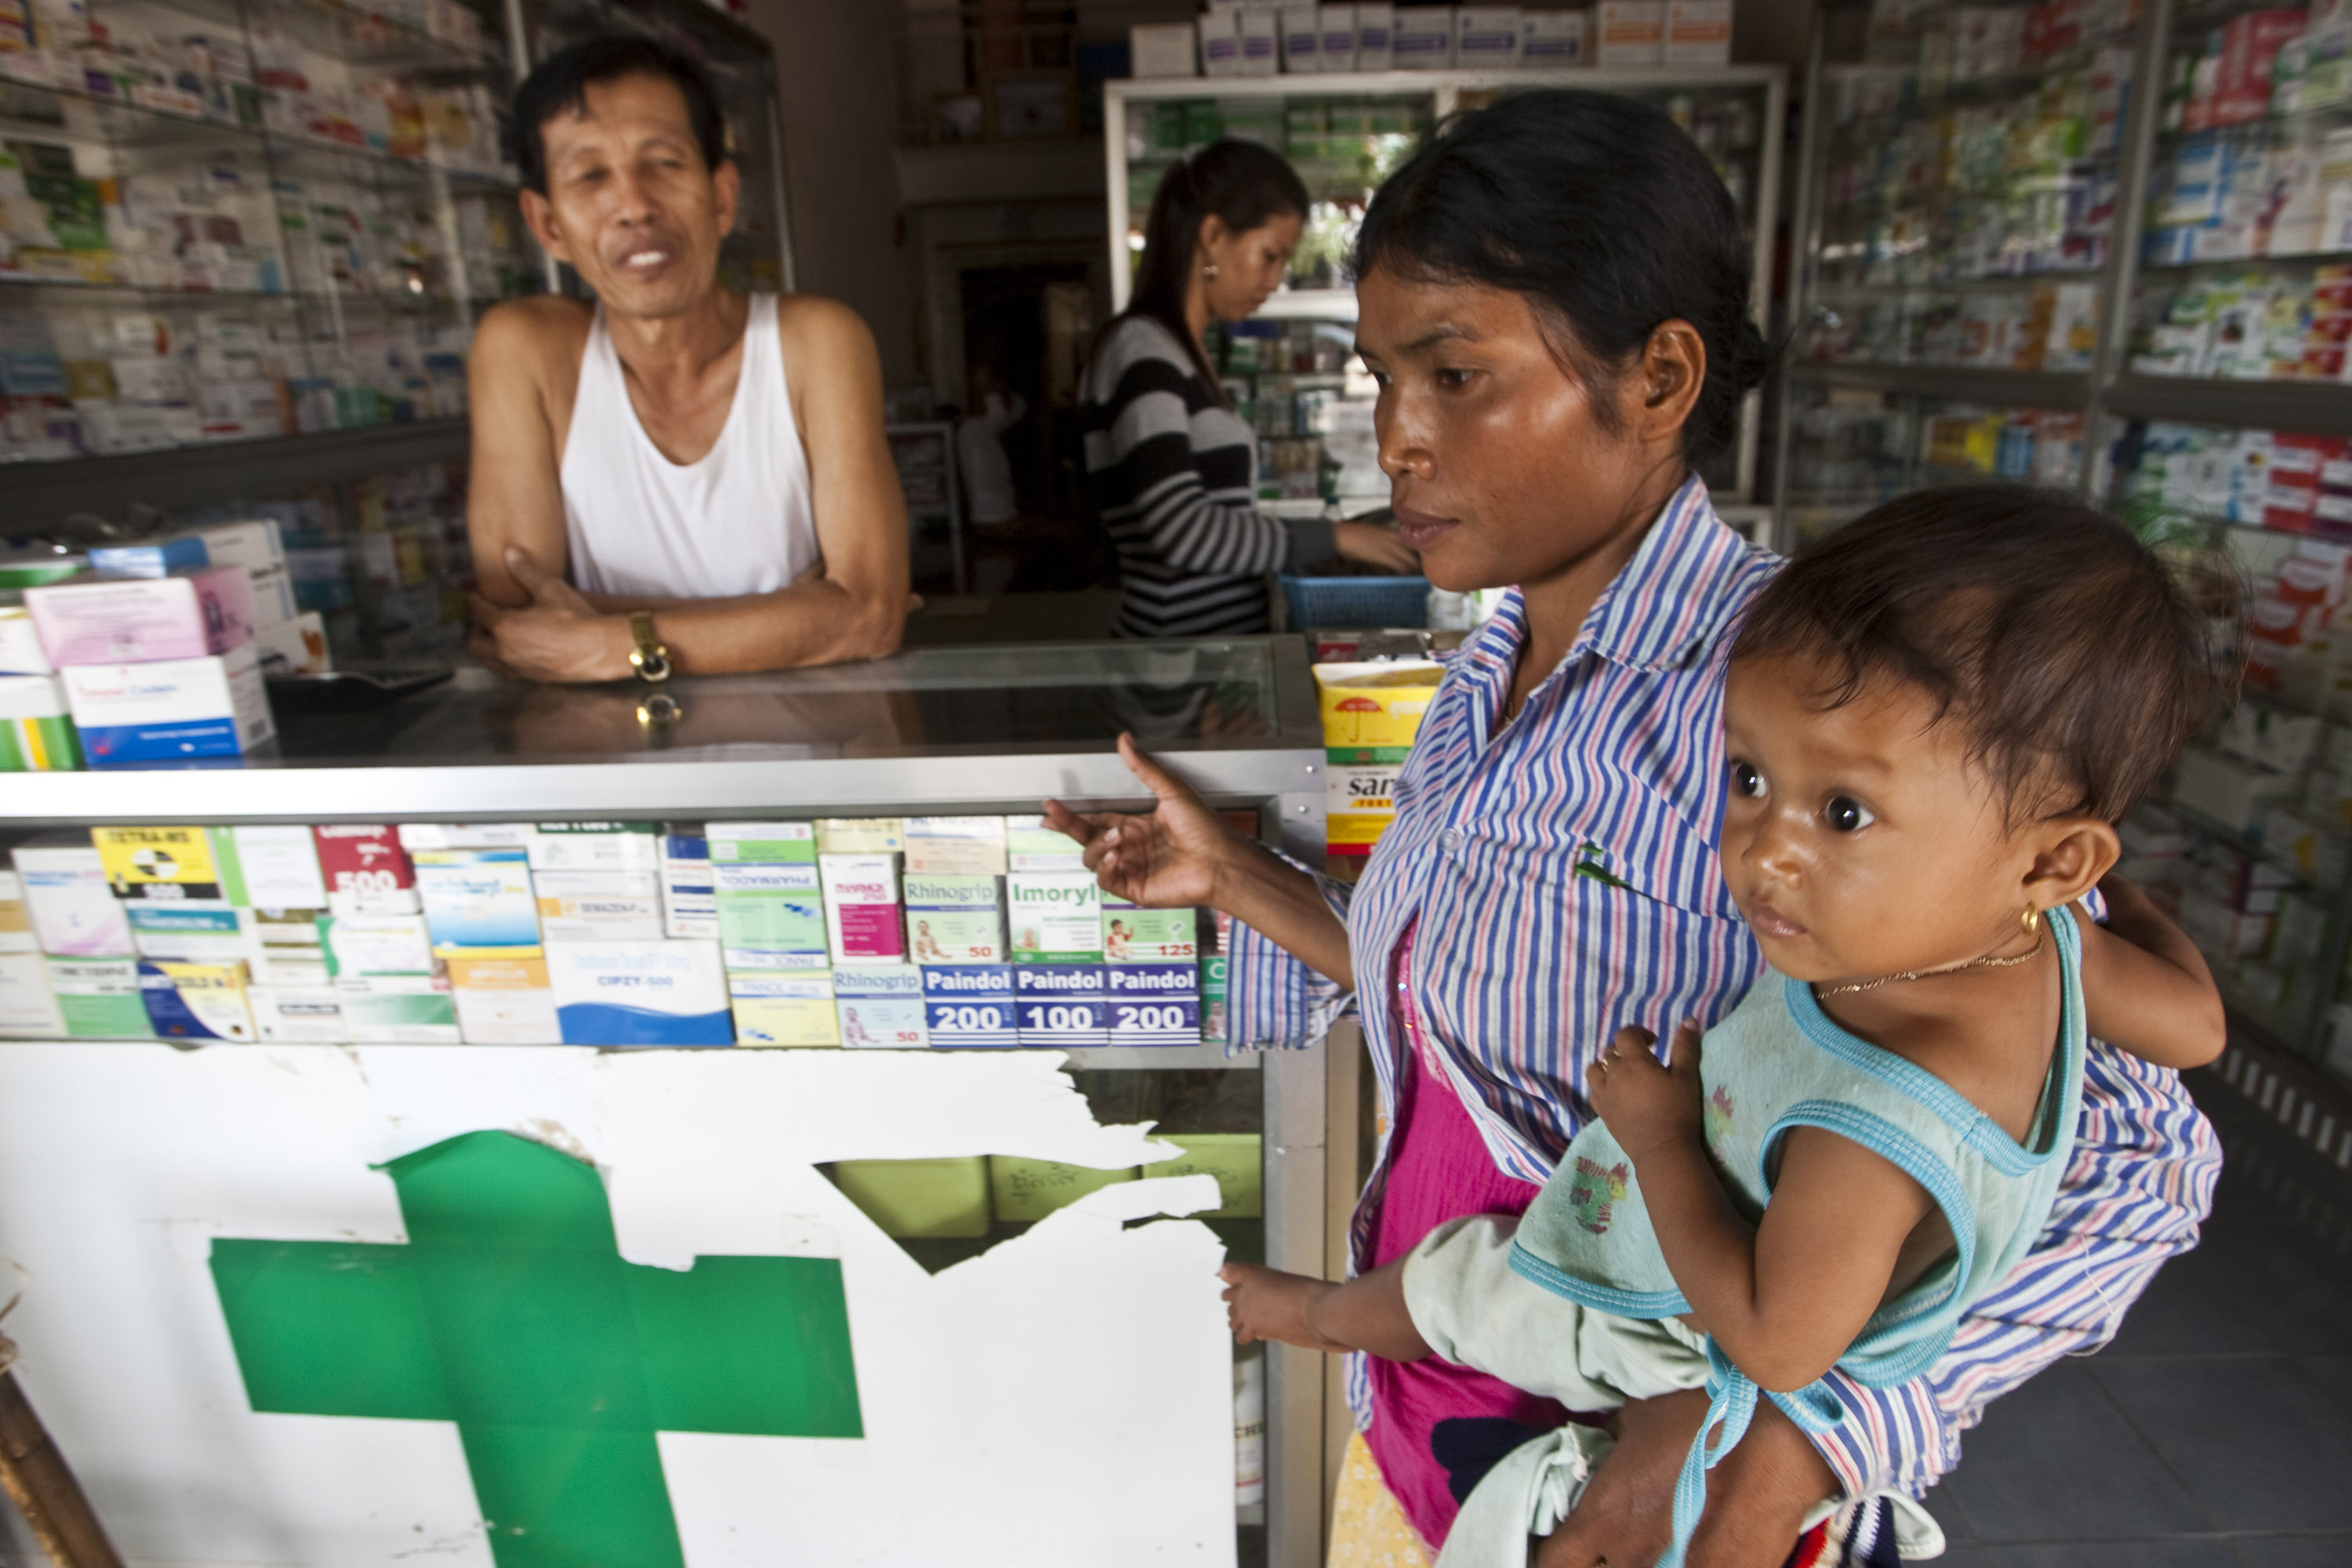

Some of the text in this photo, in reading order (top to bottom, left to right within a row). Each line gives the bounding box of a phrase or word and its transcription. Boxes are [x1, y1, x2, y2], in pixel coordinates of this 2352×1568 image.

[335, 869, 398, 893] 500
[907, 883, 993, 906] Rhinogrip
[1014, 884, 1095, 906] Imoryl
[969, 946, 992, 957] 50
[1158, 944, 1194, 956] 125
[835, 972, 919, 990] Rhinogrip
[926, 972, 1011, 990] Paindol
[1019, 971, 1103, 989] Paindol
[1110, 971, 1196, 989] Paindol
[935, 1007, 1001, 1031] 200
[1026, 1006, 1094, 1030] 100
[1116, 1006, 1185, 1029] 200
[896, 1031, 919, 1042] 50
